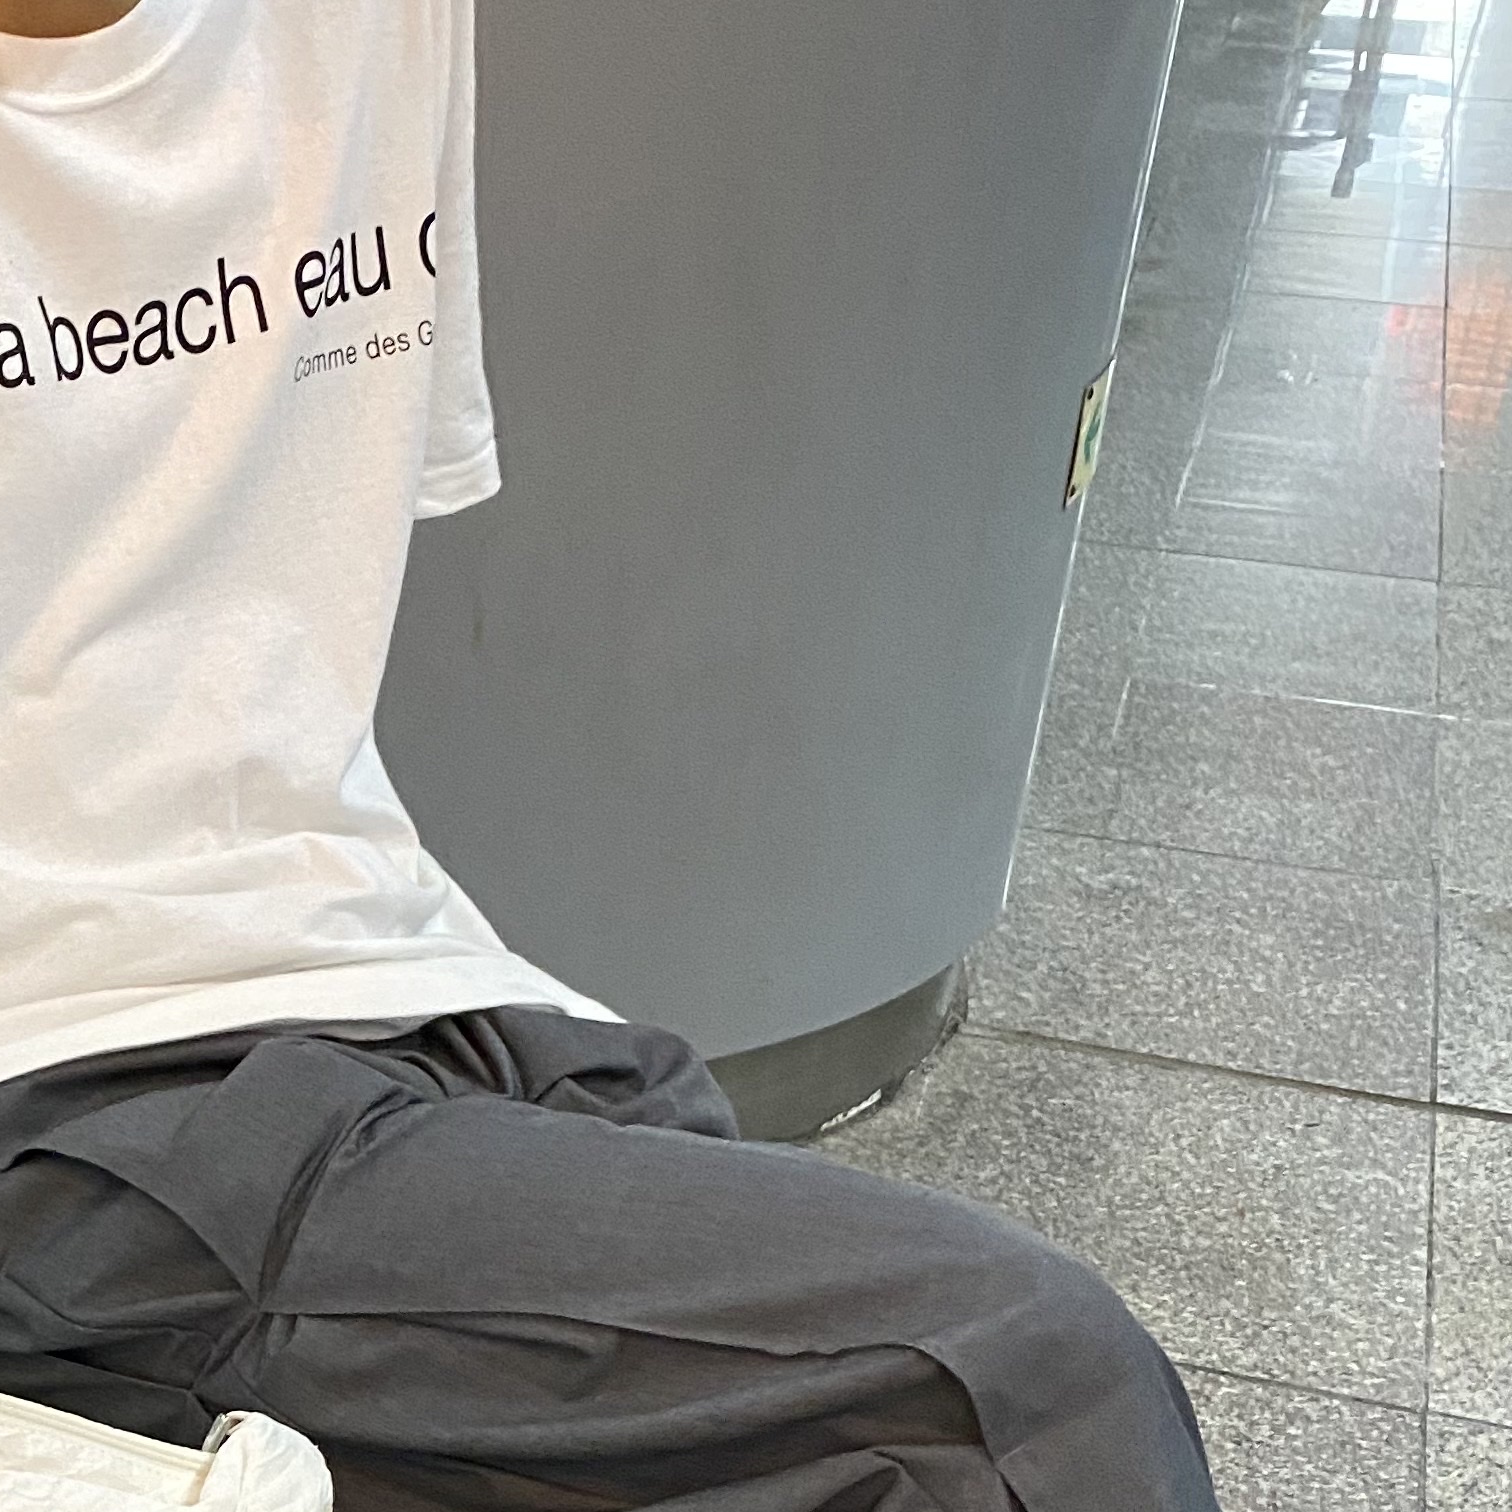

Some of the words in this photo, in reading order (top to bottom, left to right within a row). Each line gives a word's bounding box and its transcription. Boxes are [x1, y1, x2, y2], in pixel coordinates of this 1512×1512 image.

[37, 256, 270, 382] beach
[294, 225, 391, 318] eau
[294, 345, 357, 382] Comme
[365, 332, 411, 359] des
